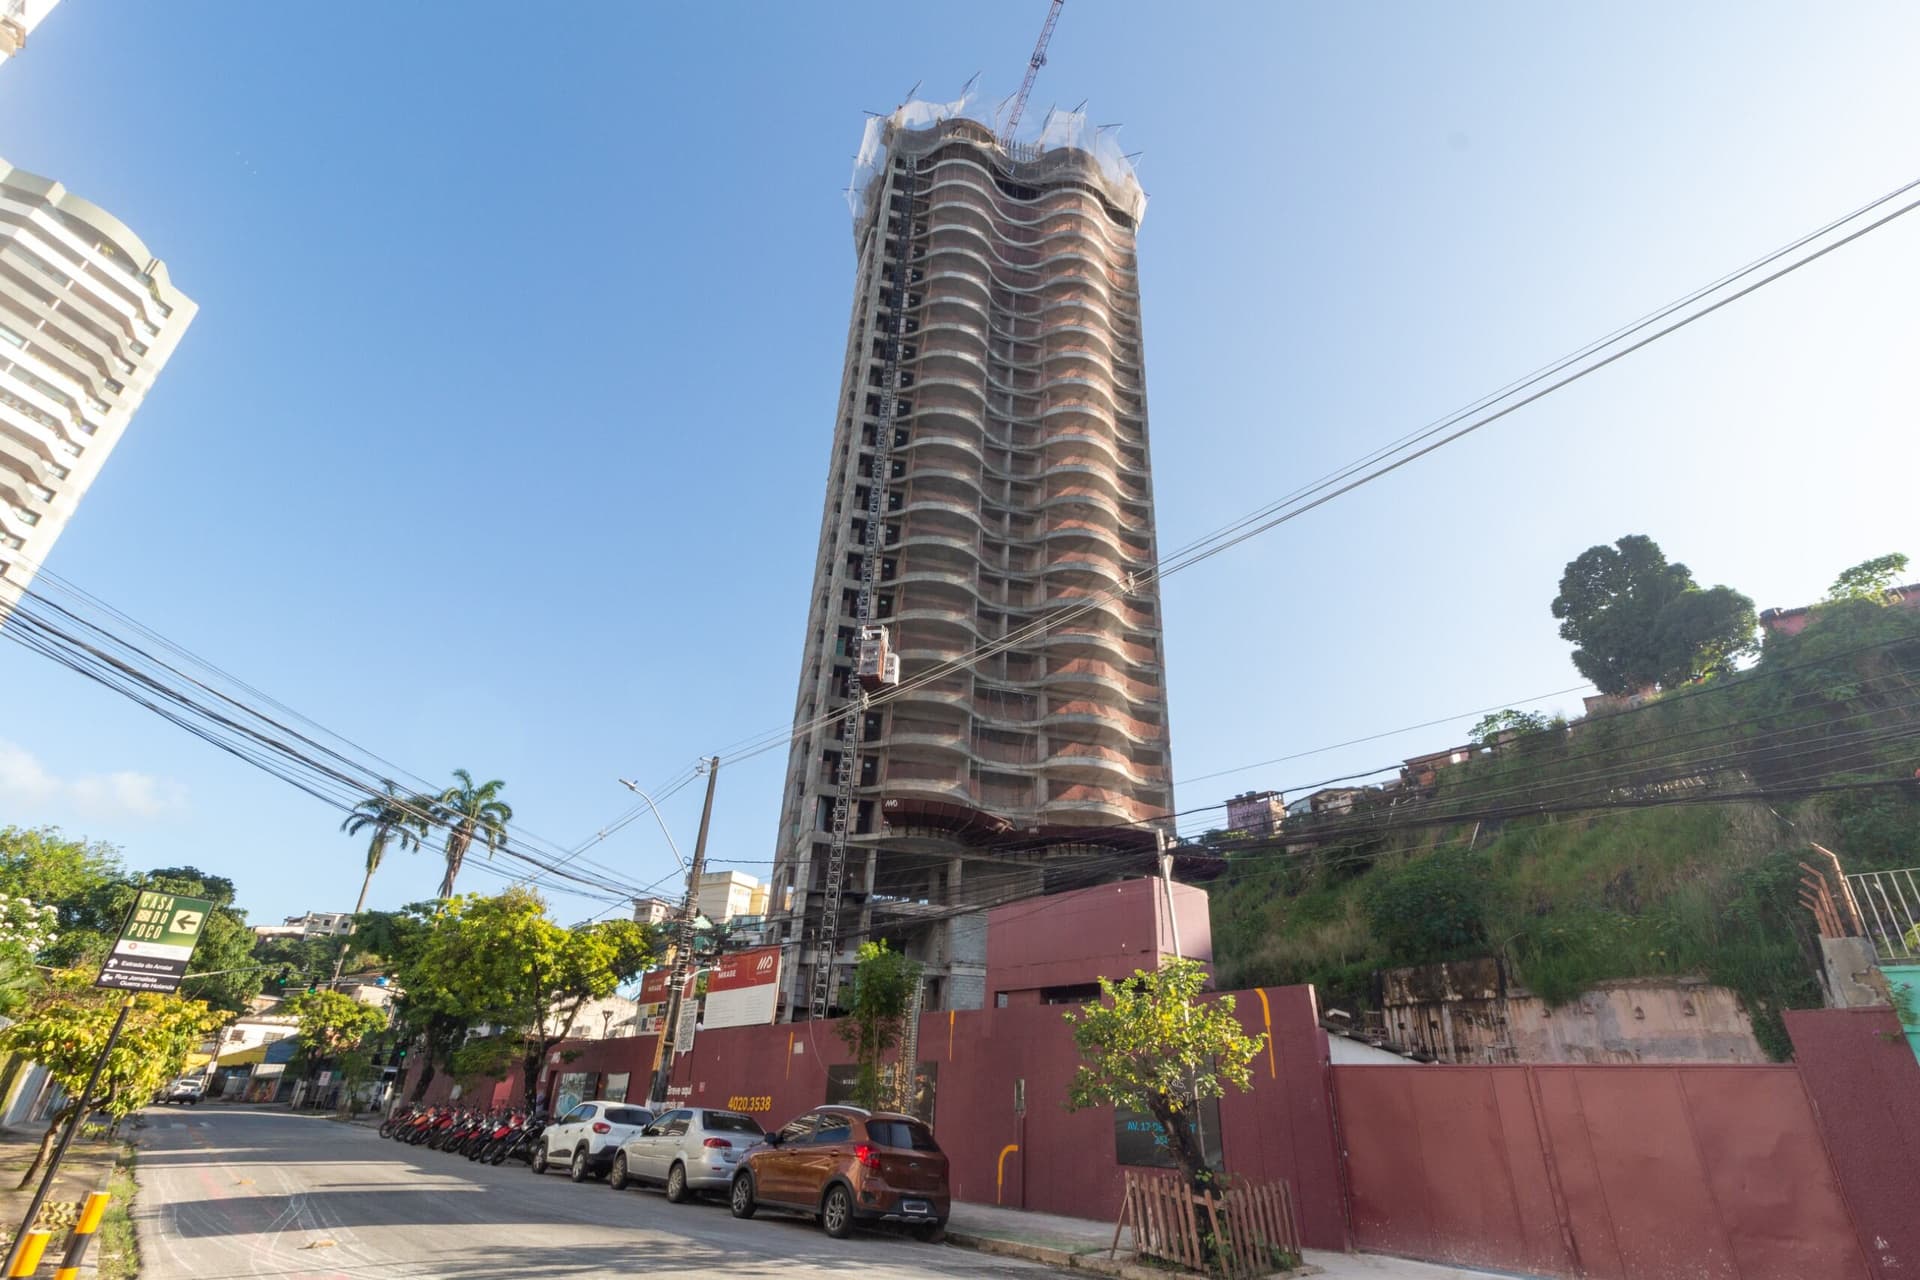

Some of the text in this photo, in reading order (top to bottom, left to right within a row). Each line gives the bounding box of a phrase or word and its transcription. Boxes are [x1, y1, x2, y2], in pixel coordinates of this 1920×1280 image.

[141, 894, 175, 911] CASA
[151, 911, 169, 924] DO
[127, 922, 163, 941] POÇO
[728, 1096, 772, 1111] 4020.3538
